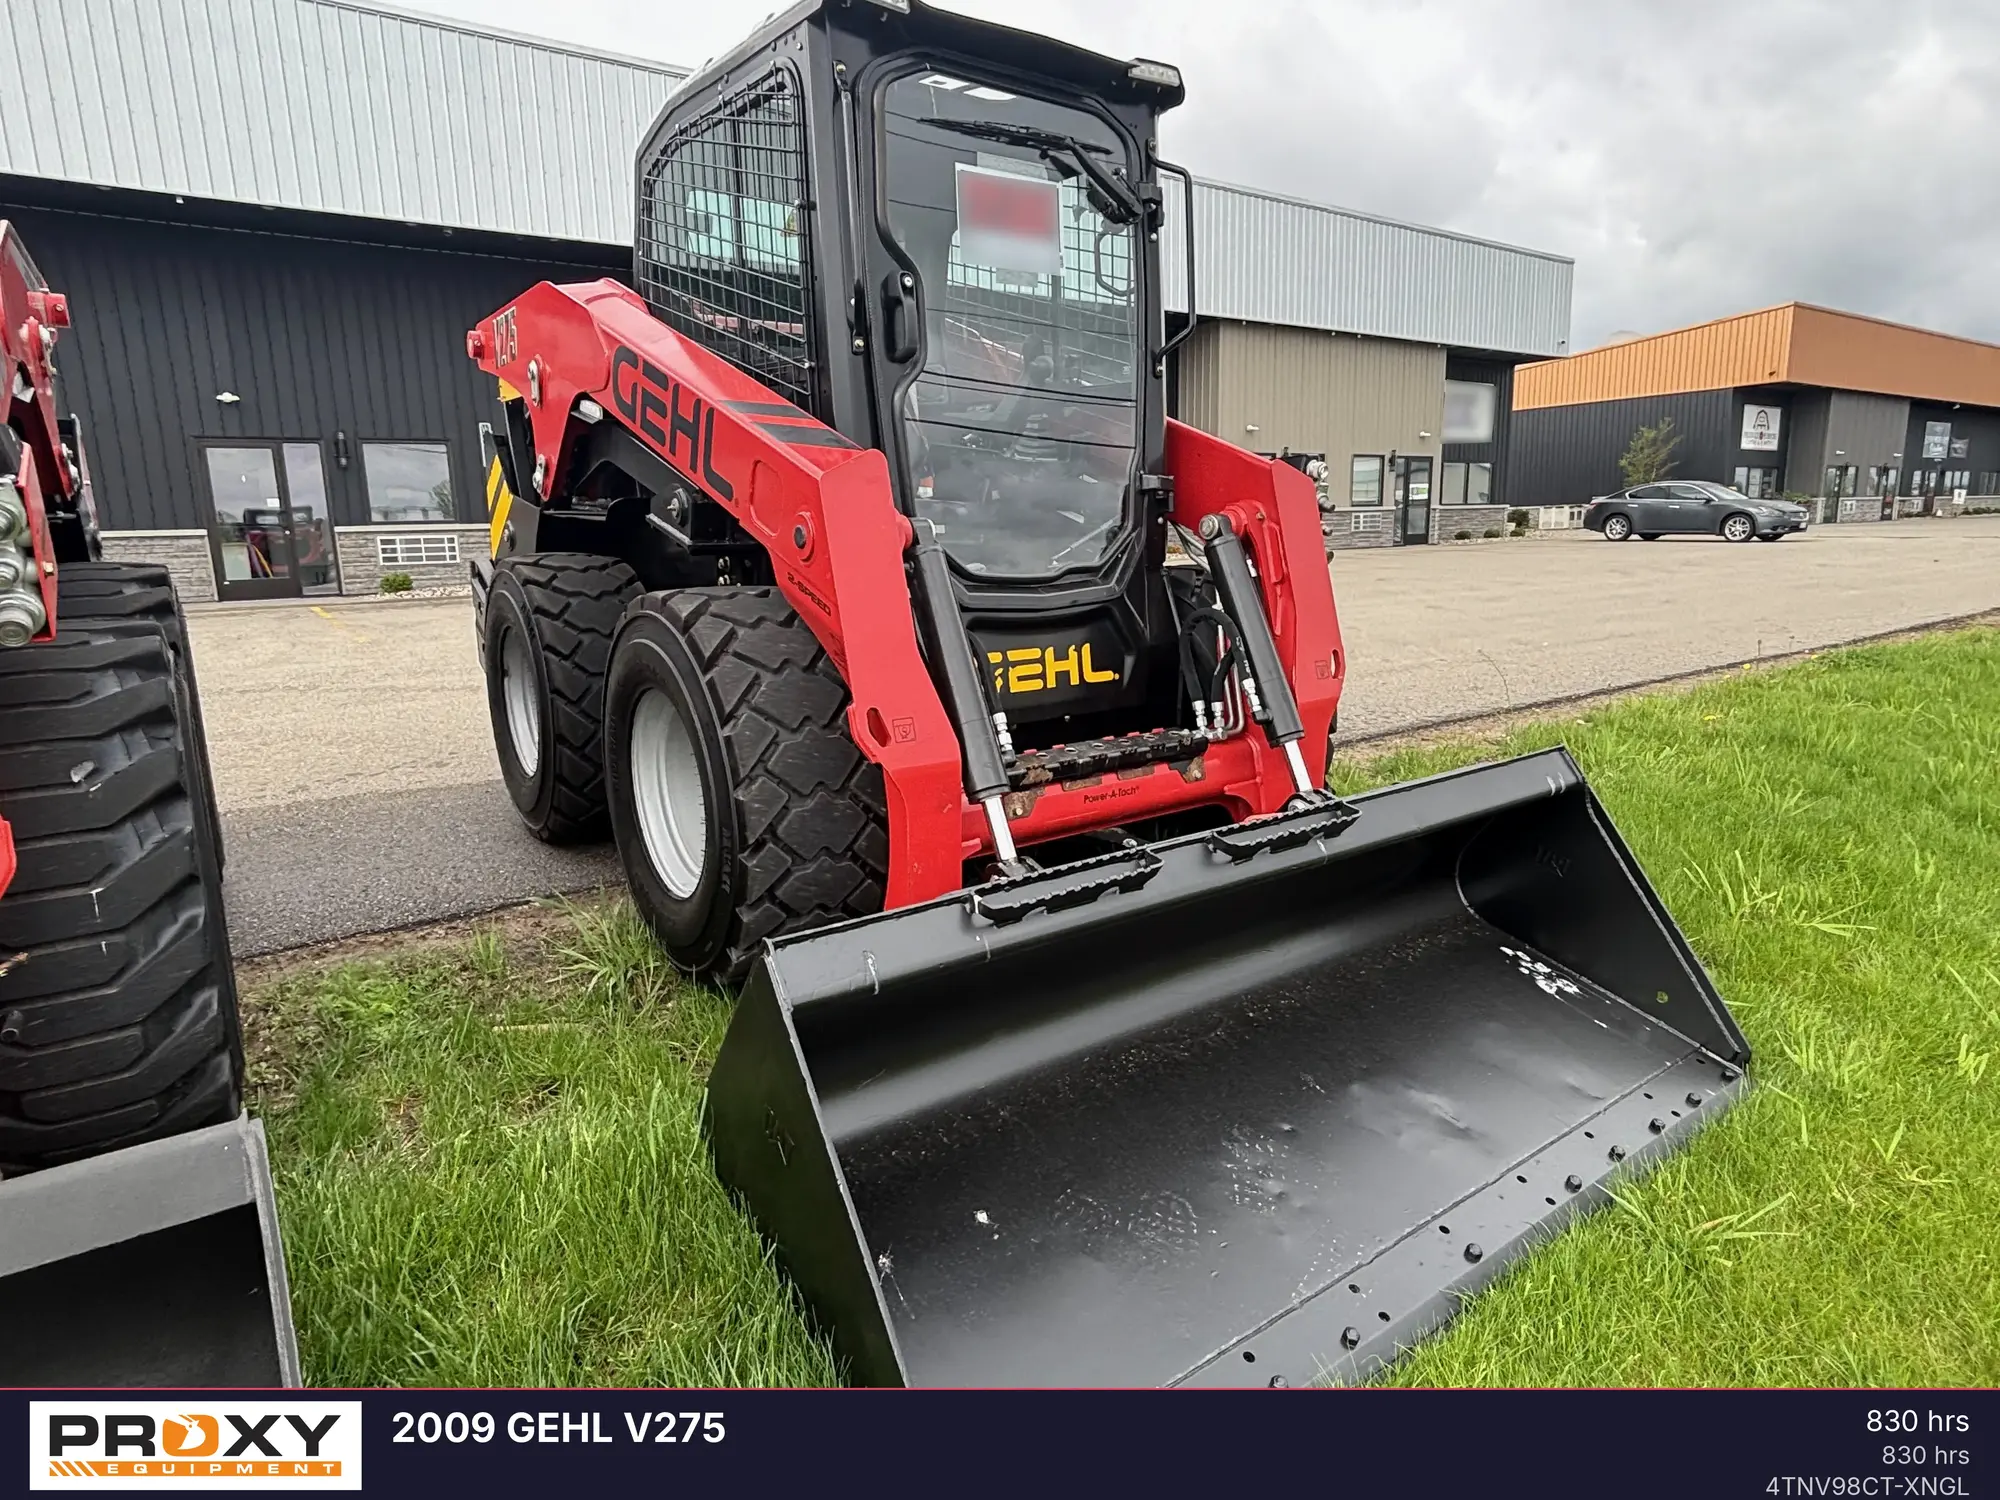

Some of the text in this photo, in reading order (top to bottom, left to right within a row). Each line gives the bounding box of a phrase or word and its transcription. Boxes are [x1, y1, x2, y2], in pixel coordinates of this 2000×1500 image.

[493, 306, 518, 369] V275
[612, 345, 734, 503] GEHL
[787, 571, 832, 617] 2-SPEED
